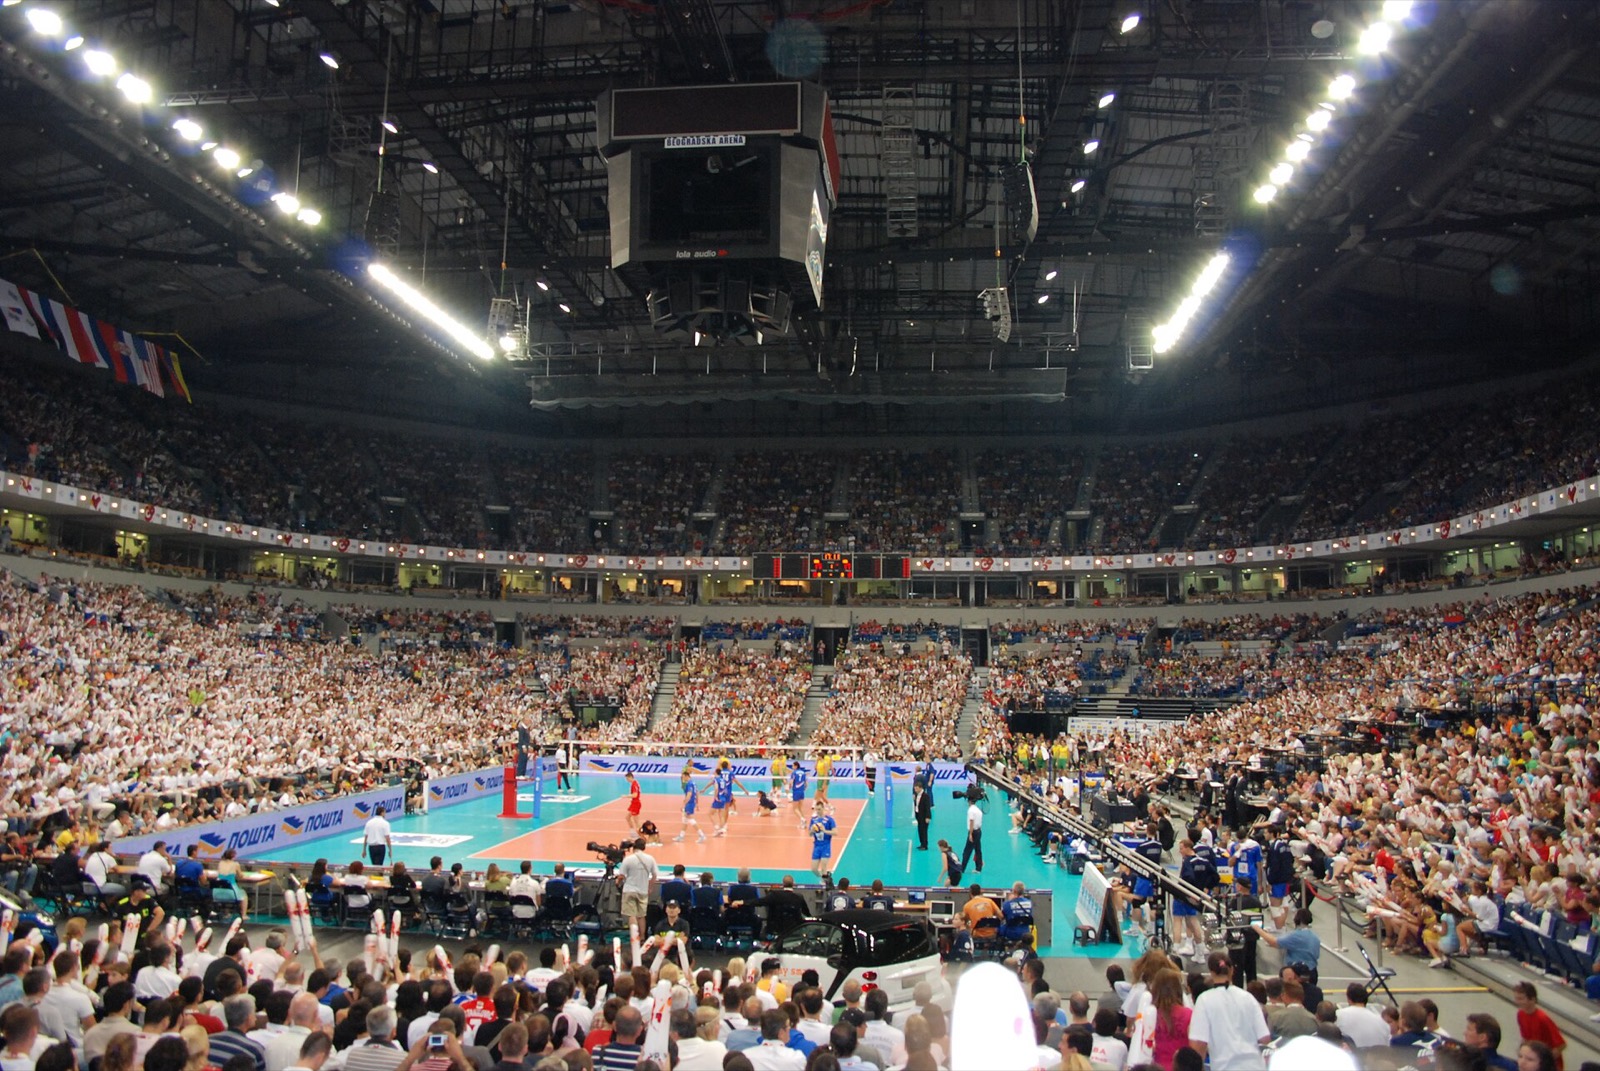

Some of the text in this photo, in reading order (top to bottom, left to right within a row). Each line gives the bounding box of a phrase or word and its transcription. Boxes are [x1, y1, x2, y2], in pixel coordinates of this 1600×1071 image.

[666, 134, 744, 147] BEOGRADSKA ARENA
[694, 249, 717, 258] audio
[616, 762, 669, 774] ПОШТА
[443, 782, 468, 799] ПОШТА
[304, 809, 344, 832] ПОШТА
[227, 823, 277, 850] ПОШТА
